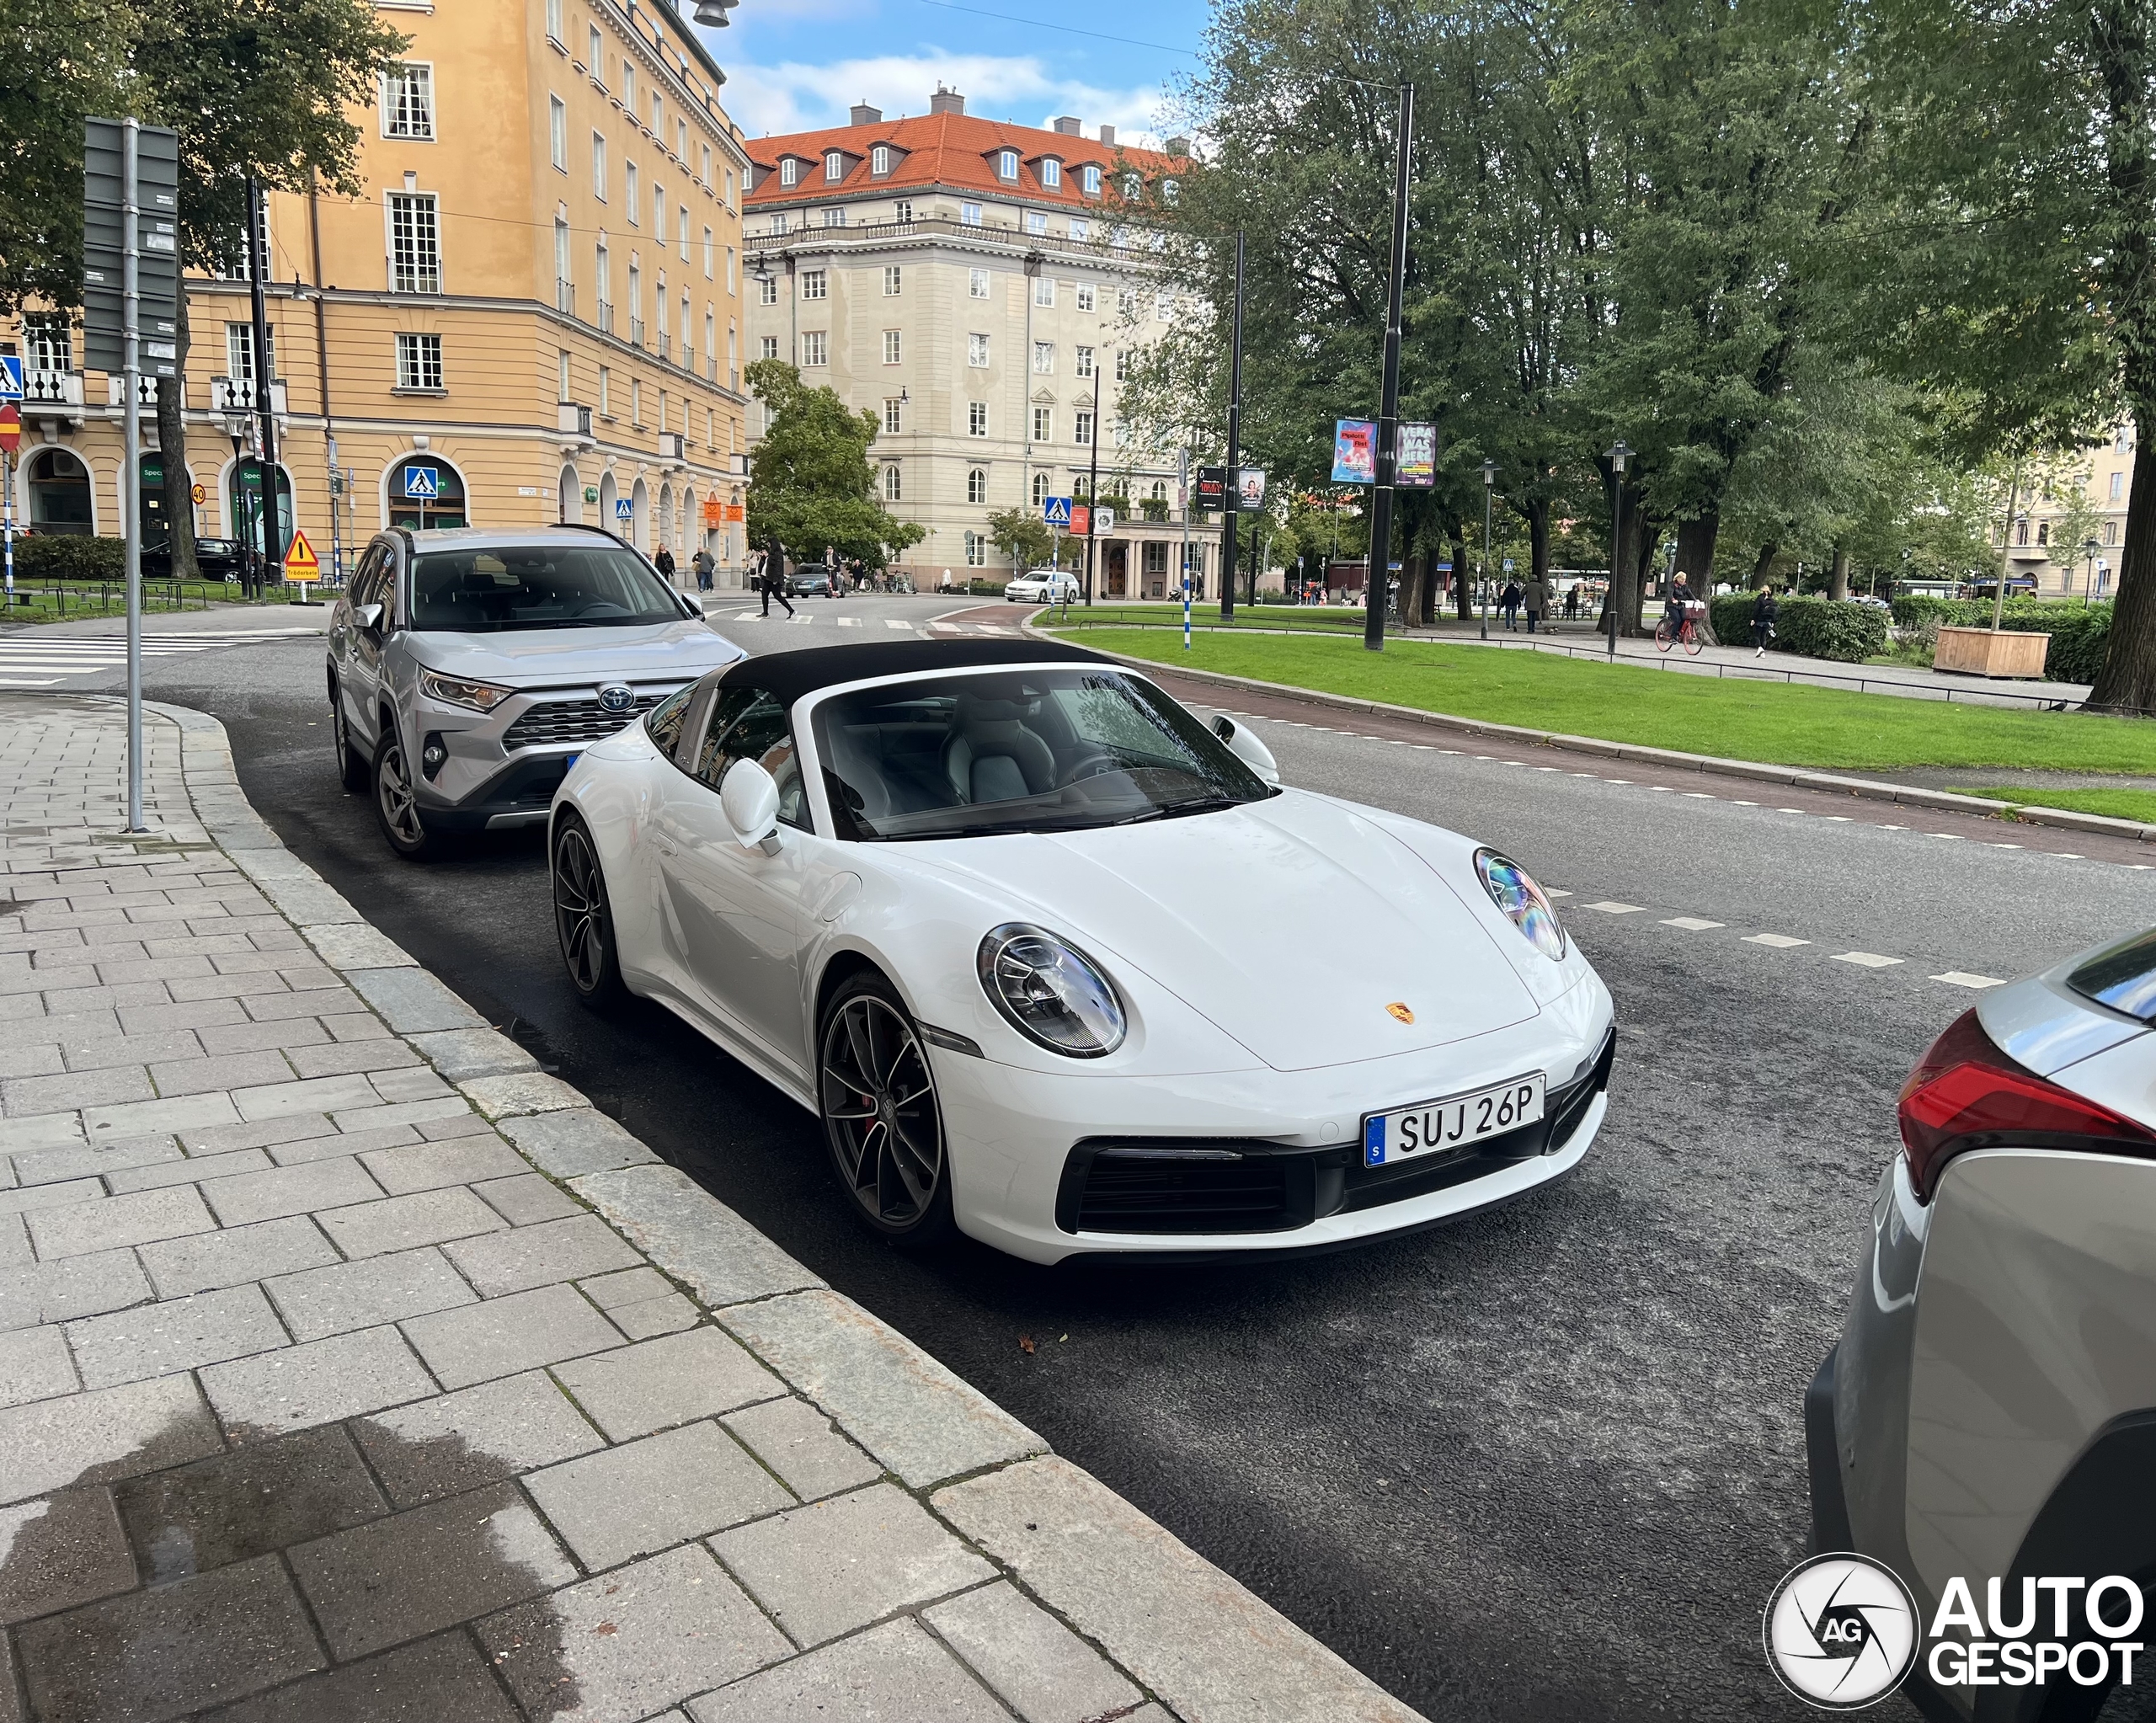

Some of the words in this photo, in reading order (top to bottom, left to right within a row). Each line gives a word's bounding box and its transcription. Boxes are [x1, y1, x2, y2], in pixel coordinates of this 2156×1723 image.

[1401, 426, 1433, 438] VERA
[1402, 439, 1430, 449] WAS
[1401, 451, 1432, 461] HERE
[193, 488, 204, 499] 40
[2097, 561, 2104, 569] T
[1400, 1103, 1465, 1153] SUJ
[1476, 1085, 1533, 1134] 26P
[1372, 1146, 1380, 1156] S
